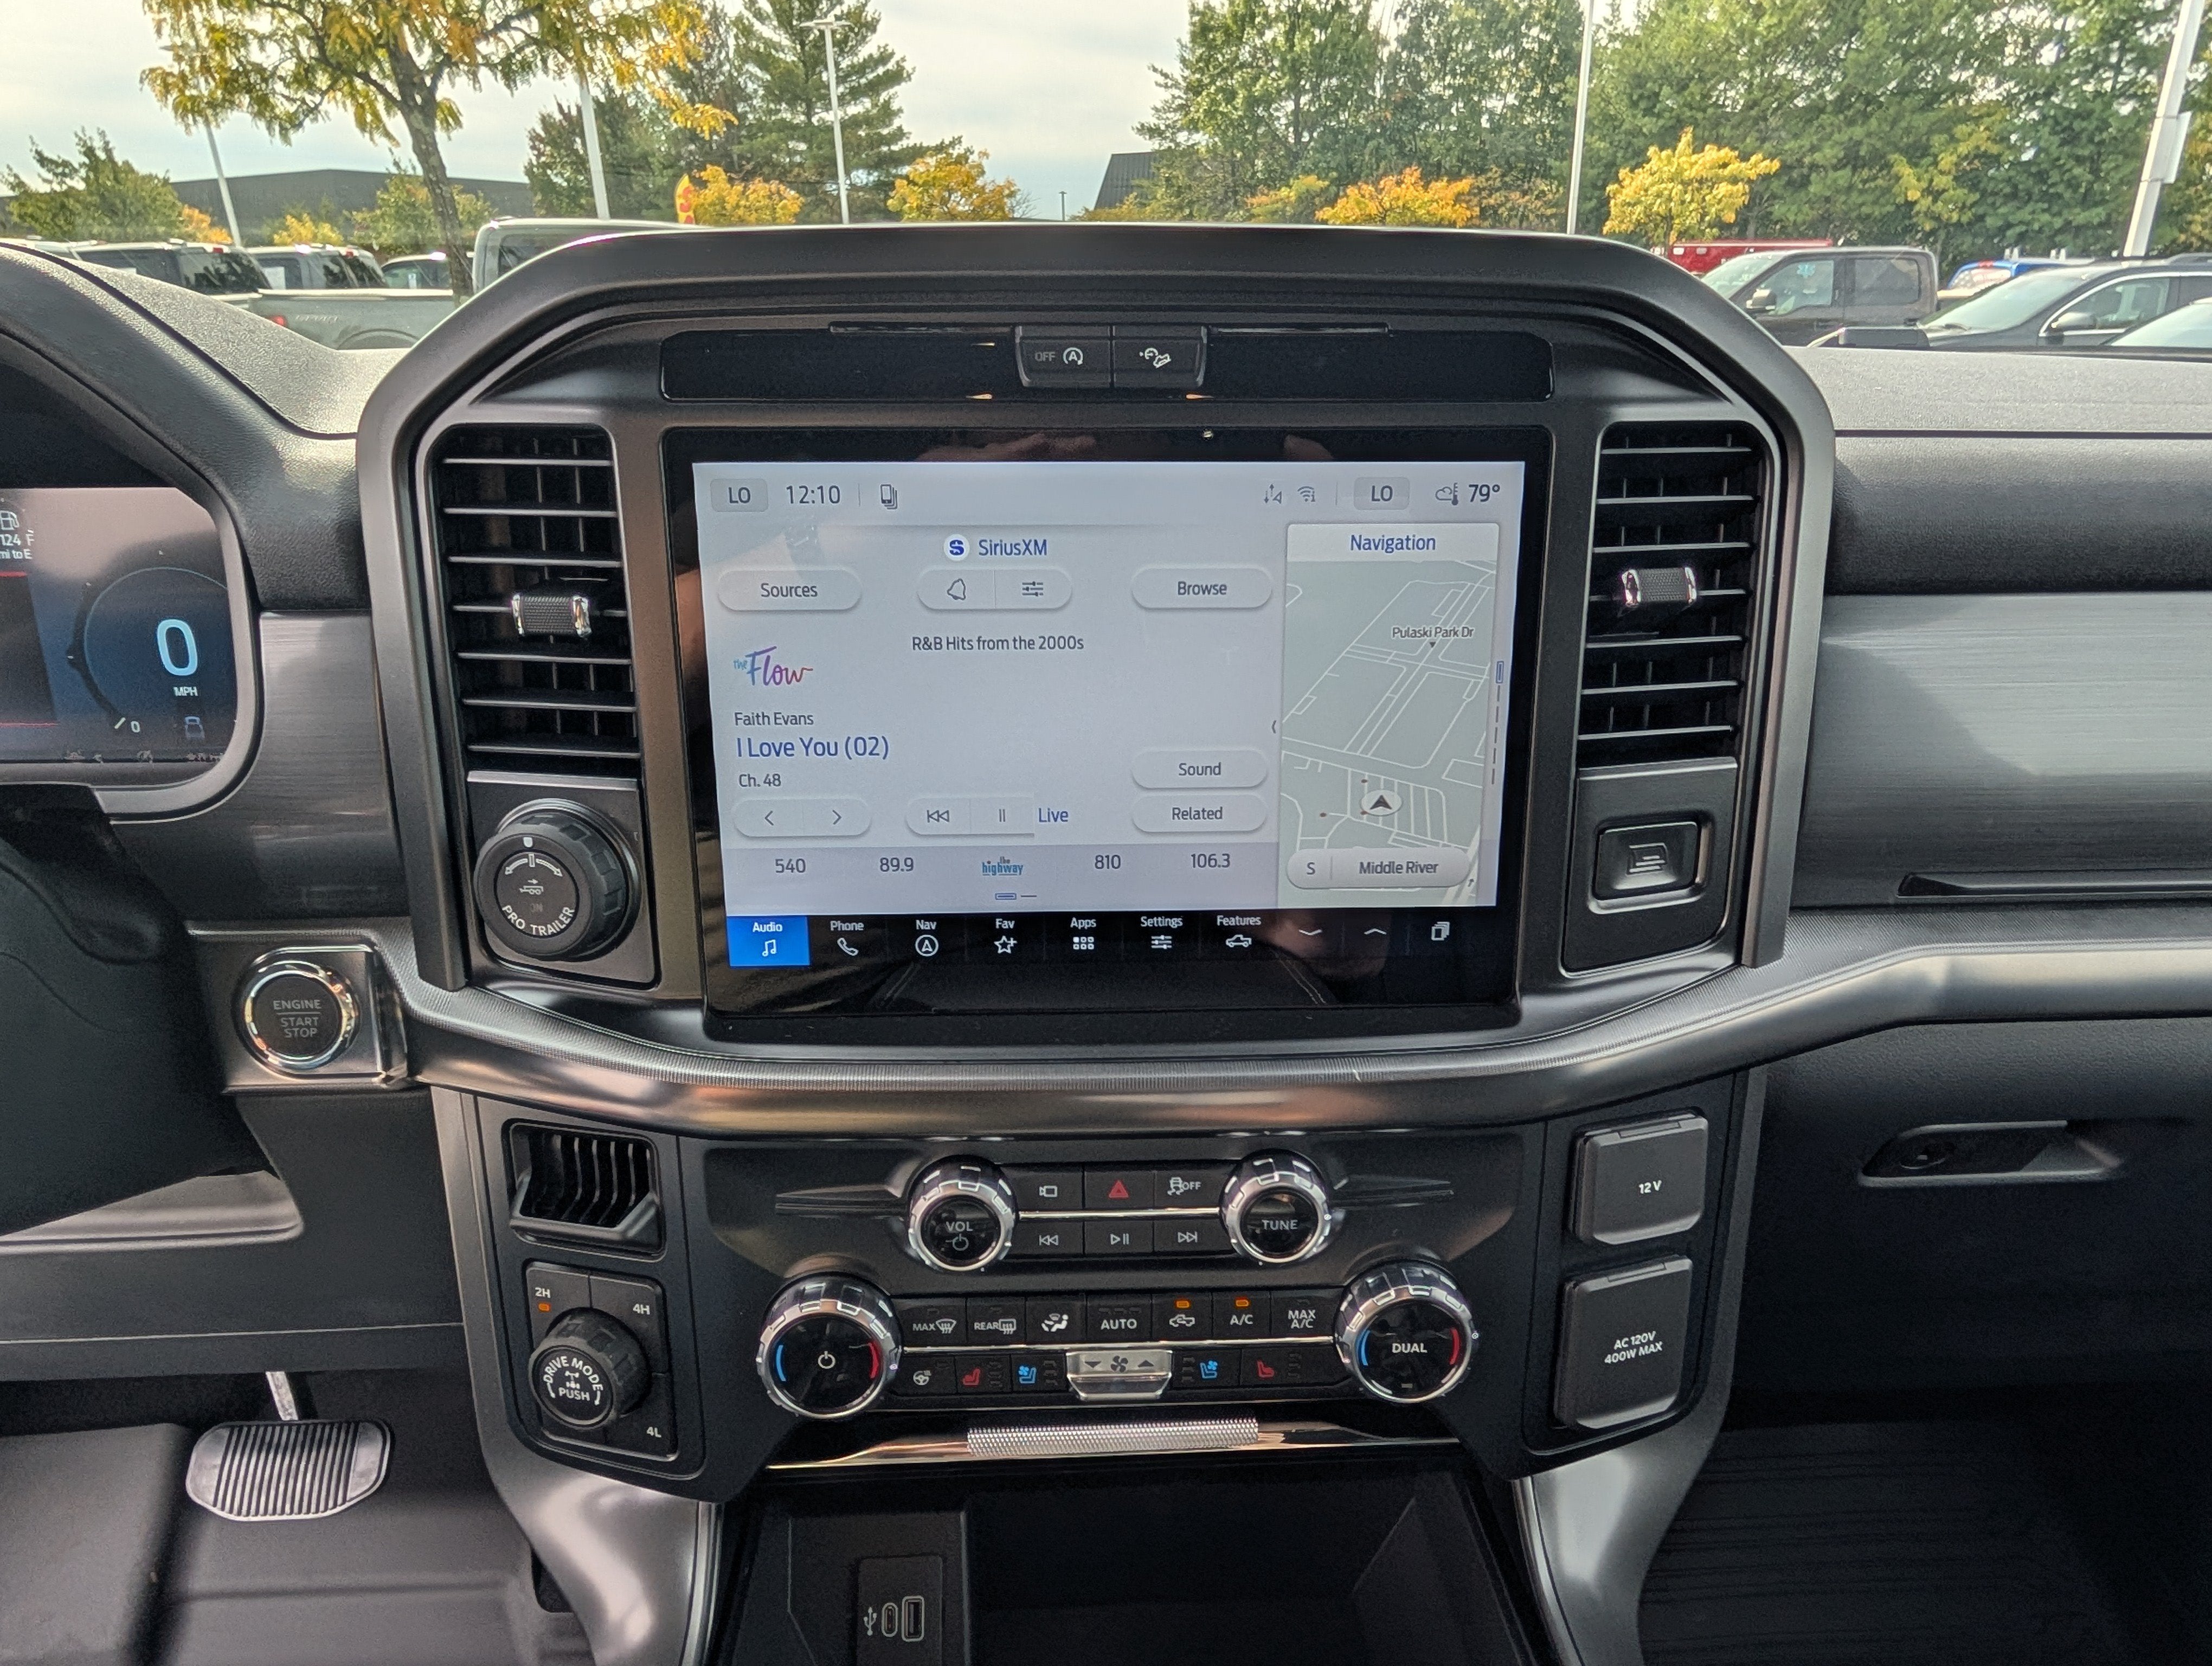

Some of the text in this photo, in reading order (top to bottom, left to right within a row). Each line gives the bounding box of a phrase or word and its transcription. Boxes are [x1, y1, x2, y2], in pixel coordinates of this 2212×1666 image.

[1034, 352, 1055, 362] OFF
[728, 486, 751, 504] LO
[786, 485, 841, 504] 12:10
[1371, 486, 1393, 502] LO
[1468, 484, 1501, 503] 79°
[25, 534, 35, 546] F
[1350, 535, 1436, 554] Navigation
[12, 550, 23, 560] to
[23, 548, 33, 560] E
[979, 539, 1047, 556] SiriusXM
[761, 583, 818, 598] Sources
[1178, 581, 1227, 596] Browse
[1392, 626, 1475, 639] Pulaski Park Dr
[157, 619, 198, 676] 0
[912, 636, 1084, 651] R&B Hits from the 2000s
[745, 645, 813, 686] Flow
[173, 686, 198, 696] MPH
[735, 712, 814, 726] Faith Evans
[131, 721, 140, 733] 0
[737, 735, 889, 760] I Love You (02)
[1179, 762, 1221, 777] Sound
[738, 773, 782, 788] Ch. 48
[1038, 808, 1069, 823] Live
[1172, 807, 1223, 821] Related
[775, 858, 806, 874] 540
[879, 857, 915, 872] 89.9
[1094, 855, 1122, 870] 810
[1191, 853, 1230, 869] 106.3
[1306, 860, 1439, 875] S Middle River
[982, 861, 1024, 876] highway
[502, 905, 575, 936] PRO TRAILER
[752, 921, 783, 933] Audio
[830, 920, 864, 932] Phone
[916, 919, 937, 931] Nav
[995, 918, 1015, 930] Fav
[1070, 917, 1096, 930] Apps
[1140, 915, 1183, 929] Settings
[1217, 915, 1262, 926] Features
[273, 999, 322, 1010] ENGINE
[281, 1017, 319, 1027] START
[284, 1028, 318, 1038] STOP
[1182, 1180, 1201, 1191] OFF
[1638, 1180, 1662, 1194] 12 V
[946, 1221, 973, 1232] VOL
[1262, 1220, 1298, 1231] TUNE
[535, 1287, 551, 1298] 2H
[633, 1304, 650, 1315] 4H
[1288, 1309, 1316, 1320] MAX
[913, 1322, 935, 1331] MAX
[974, 1321, 999, 1331] REAR
[1101, 1319, 1137, 1330] AUTO
[1230, 1314, 1253, 1325] A/C
[1290, 1319, 1314, 1329] A/C
[1613, 1330, 1657, 1350] AC 120V
[1392, 1343, 1427, 1354] DUAL
[1605, 1341, 1663, 1364] 400W MAX
[543, 1356, 603, 1391] DRIVE MODE
[558, 1387, 590, 1401] PUSH
[646, 1427, 661, 1438] 4L
